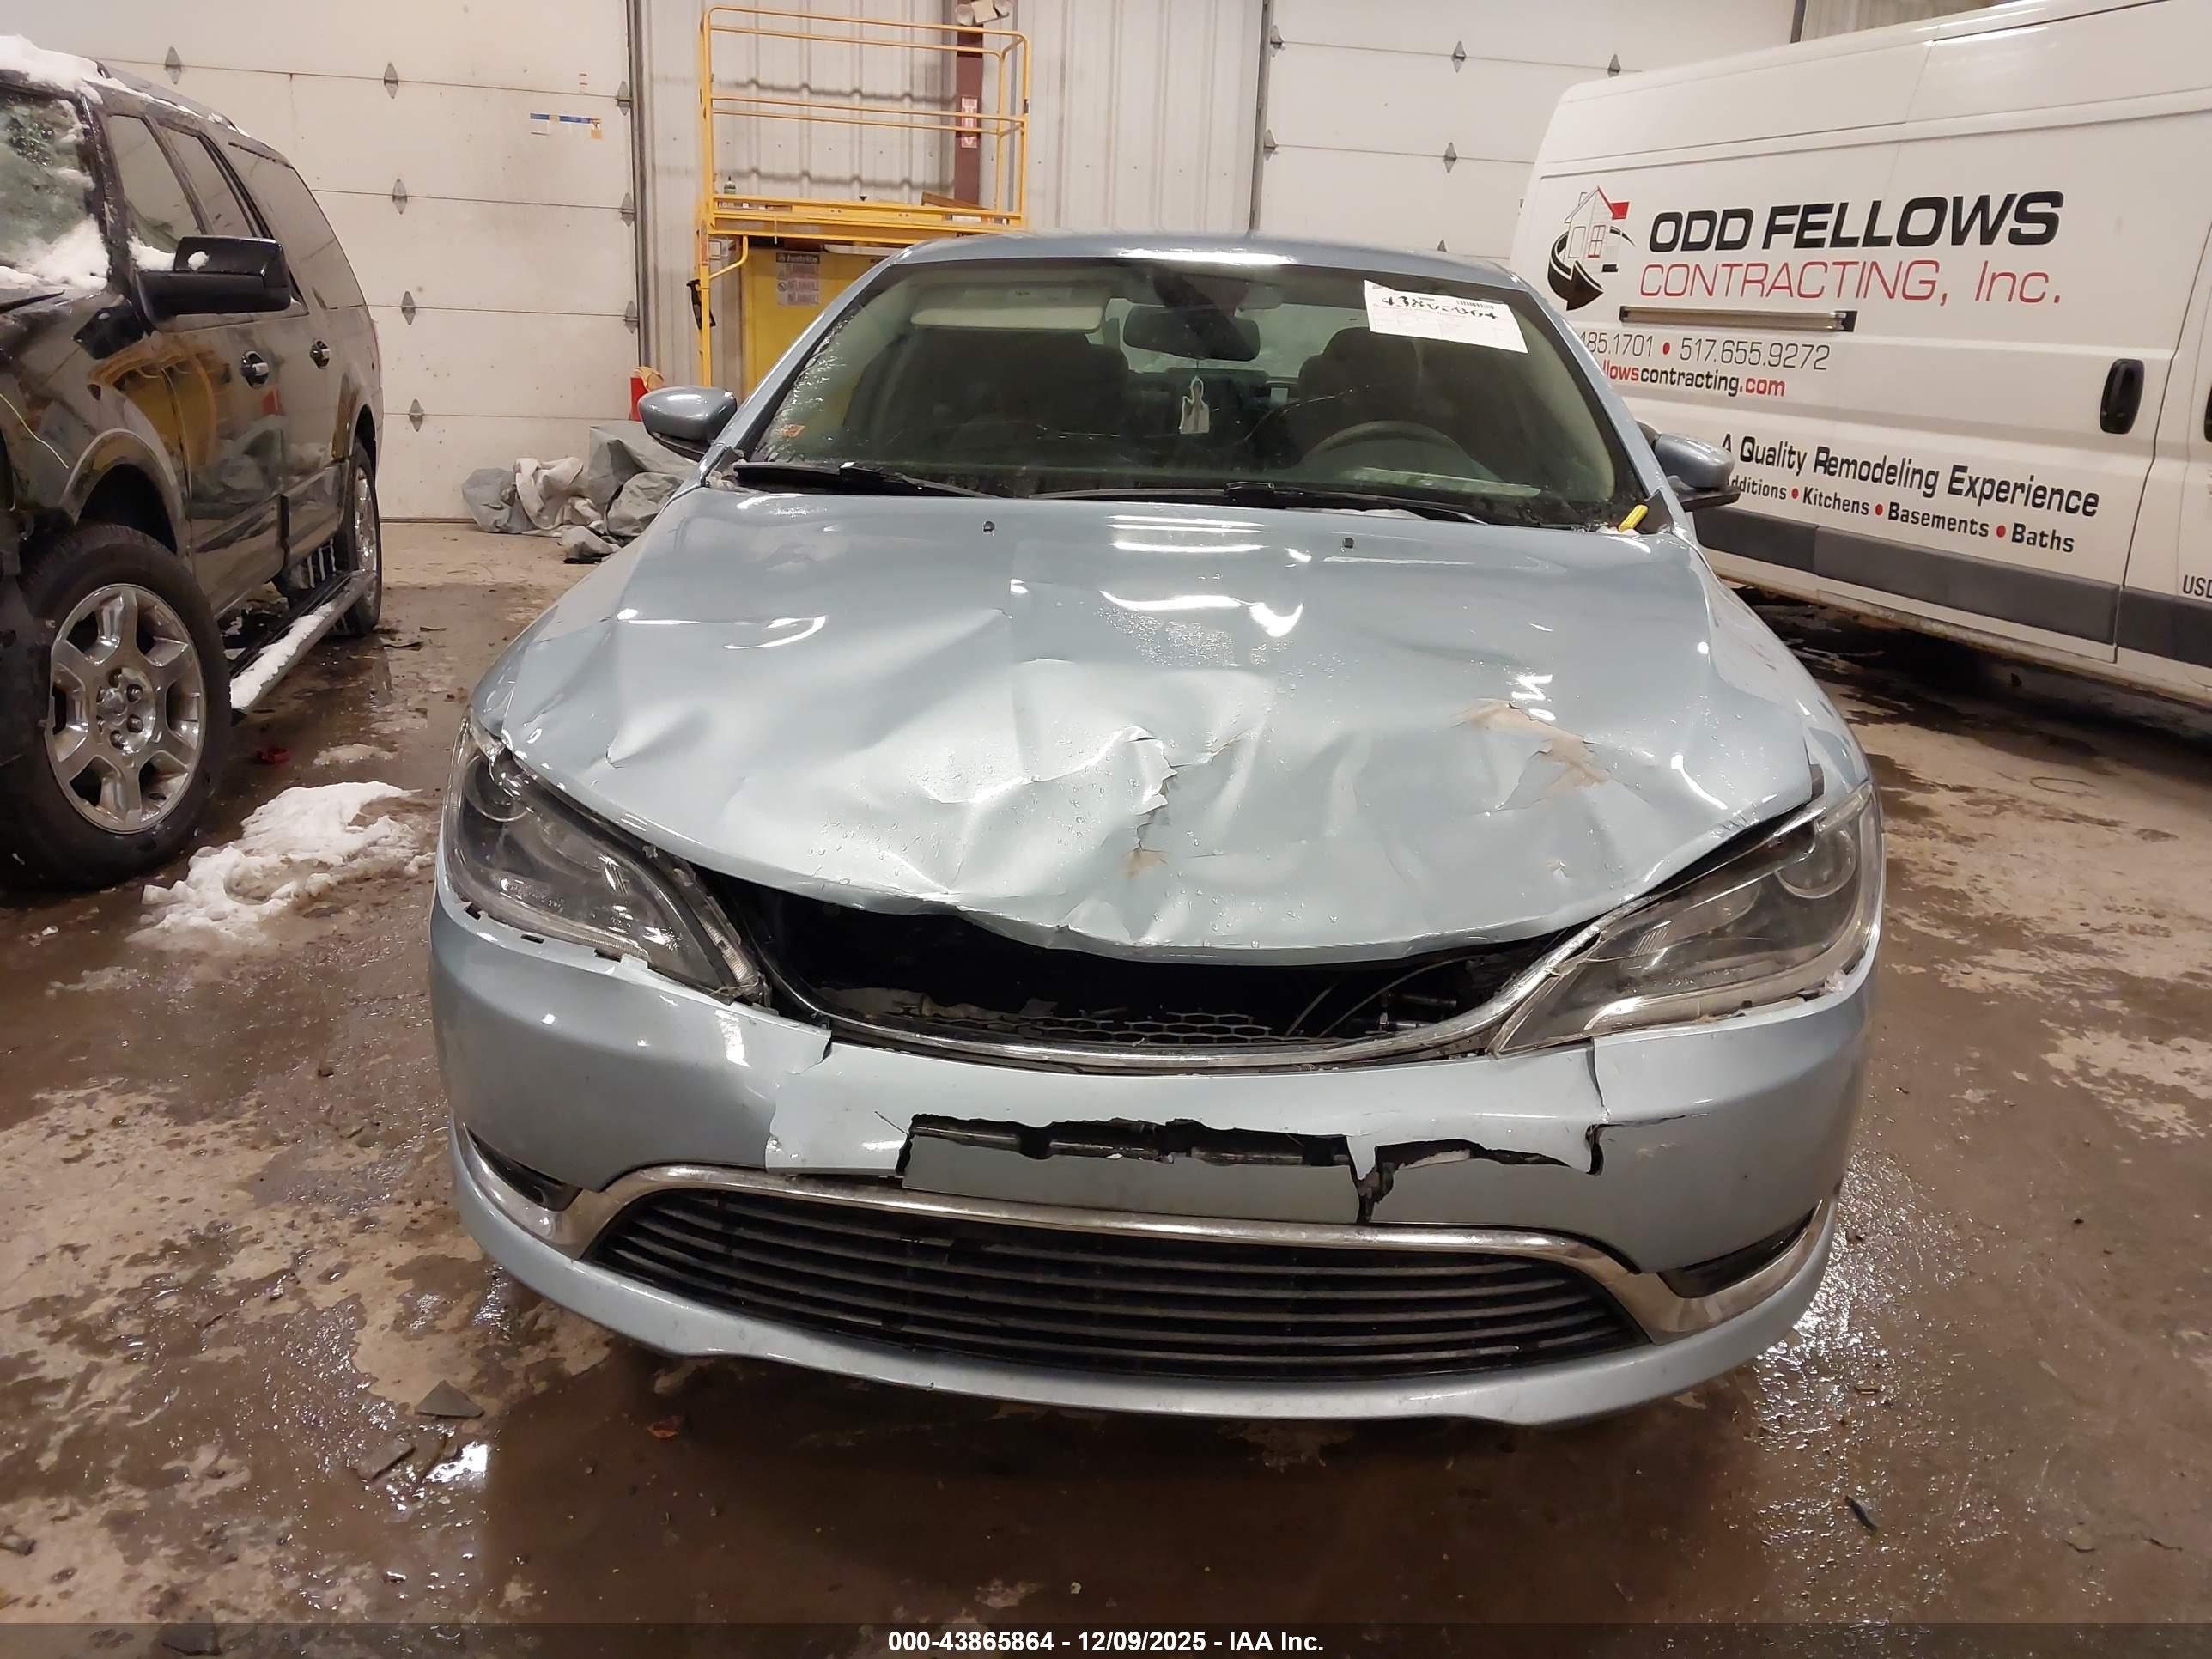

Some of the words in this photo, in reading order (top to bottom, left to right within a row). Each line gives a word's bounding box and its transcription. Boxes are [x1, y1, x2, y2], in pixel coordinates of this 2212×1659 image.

[1649, 208, 1754, 252] ODD
[1762, 191, 2064, 249] FELLOWS
[1640, 260, 1948, 307] CONTRACTING,
[1974, 260, 2061, 303] Inc.
[1680, 337, 1830, 370] 517.655.9272
[1722, 433, 1732, 453] A
[1740, 435, 1808, 477] Quality
[1813, 446, 1940, 498] Remodeling
[1947, 465, 2100, 517] Experience
[1727, 474, 1787, 500] dditions
[1802, 486, 1870, 515] Kitchens
[1887, 501, 1990, 538] Basements
[2011, 523, 2075, 554] Baths
